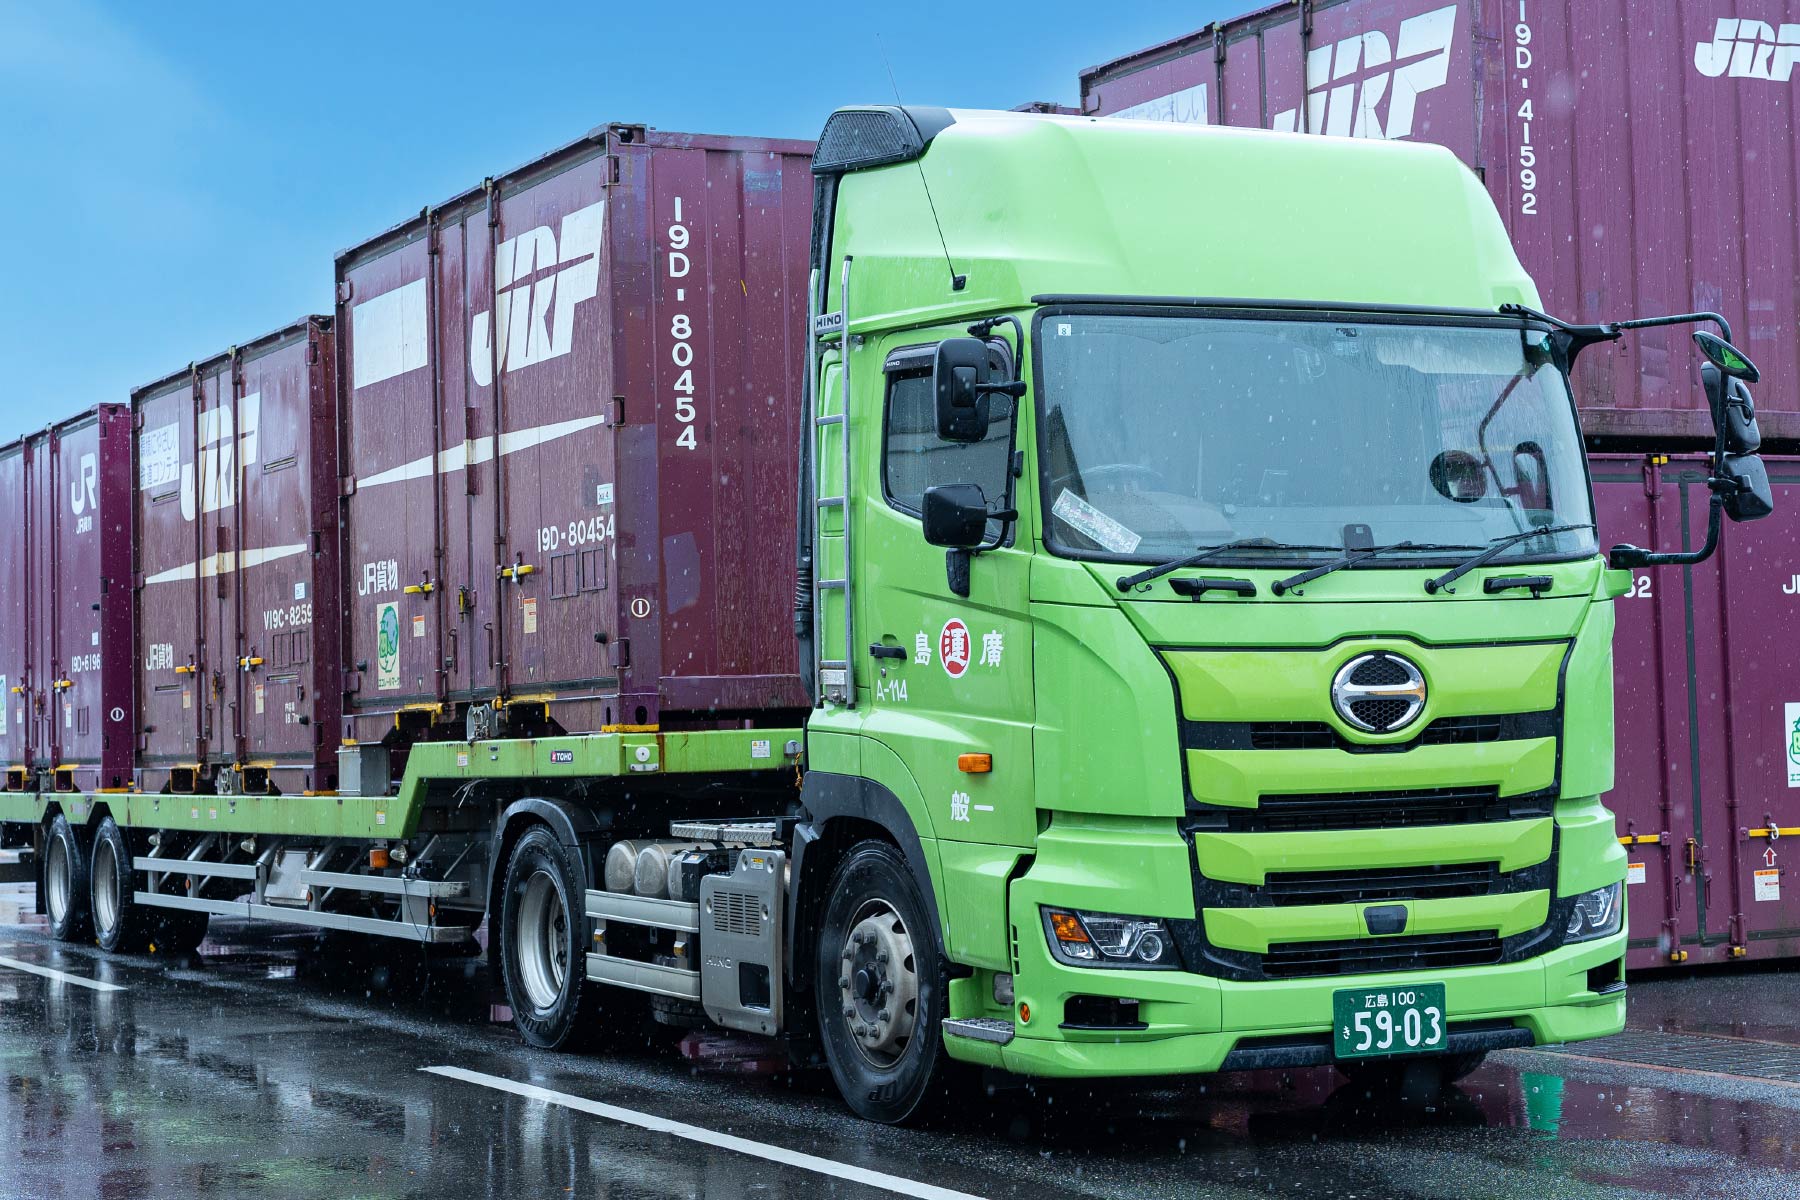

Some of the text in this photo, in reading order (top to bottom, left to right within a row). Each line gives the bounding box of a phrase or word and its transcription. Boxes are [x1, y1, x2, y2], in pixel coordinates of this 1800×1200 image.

[1514, 0, 1537, 215] 19D-41592
[471, 200, 605, 387] JRF
[667, 195, 697, 451] 19D-80454
[816, 314, 842, 328] HINO
[71, 452, 97, 515] JR
[537, 513, 615, 553] 19D-80454
[358, 558, 398, 596] JR貨物
[146, 642, 174, 671] JR貨物
[876, 679, 908, 702] A-114
[1364, 991, 1416, 1008] 広島 100
[1354, 1006, 1442, 1051] 59-03
